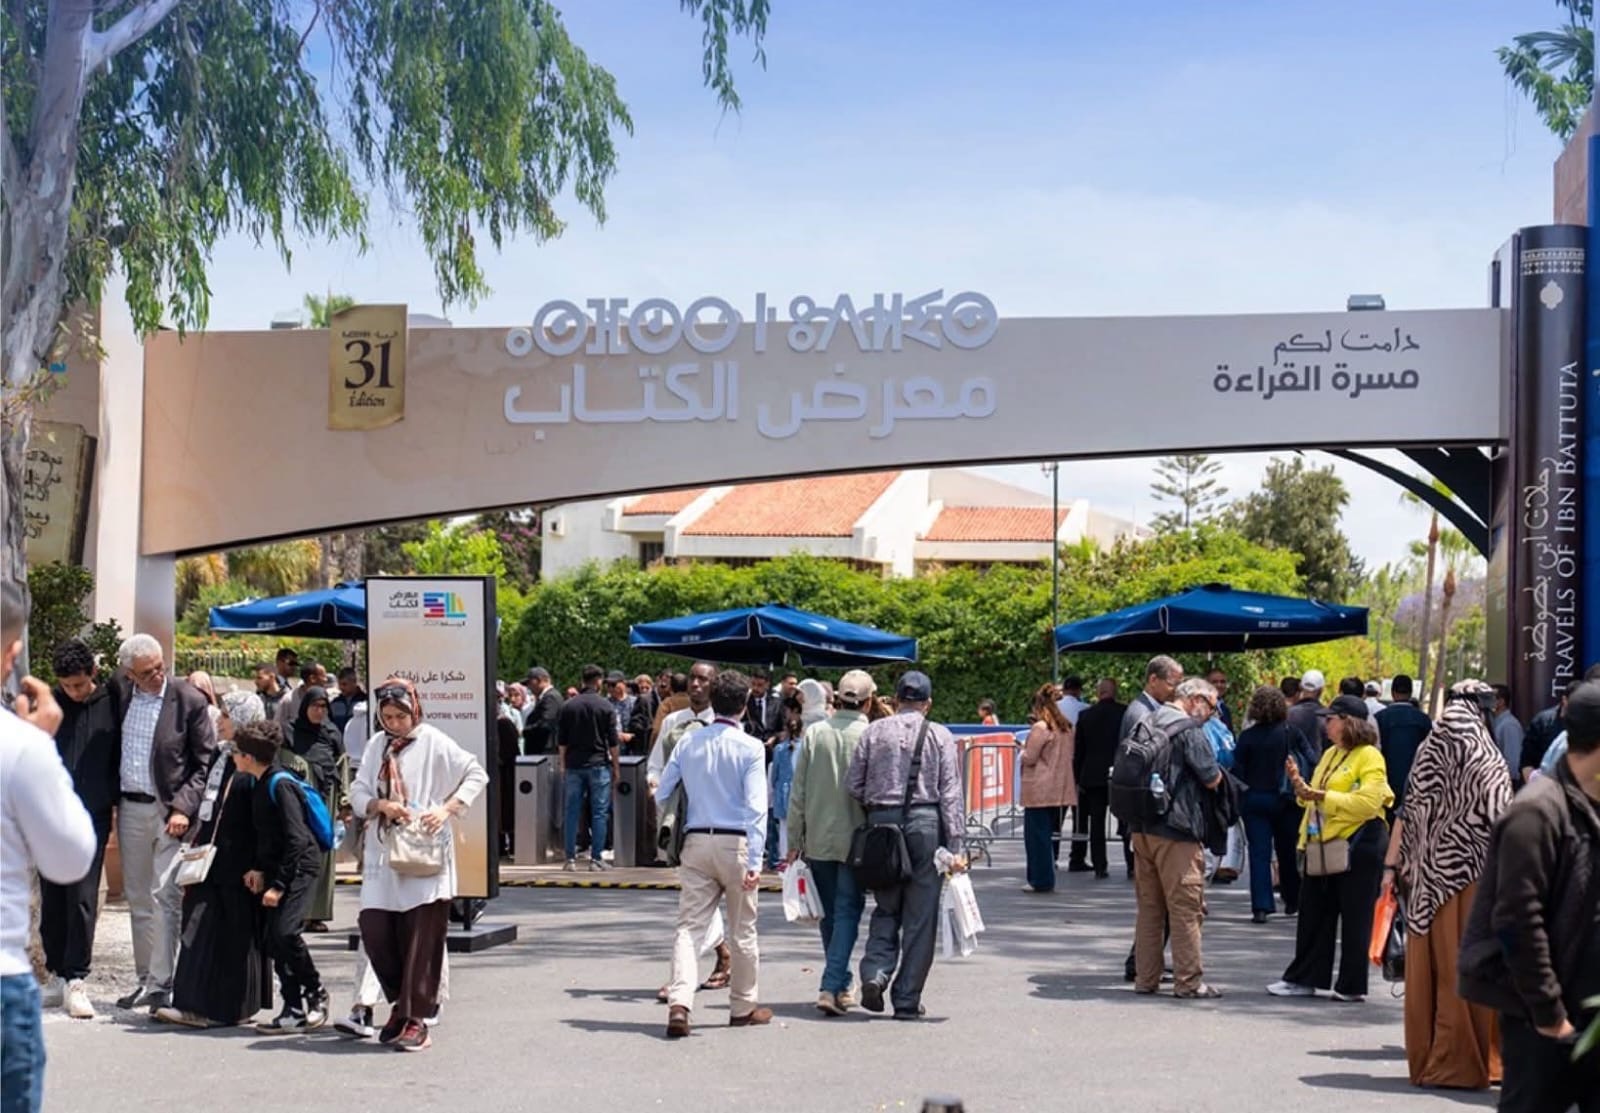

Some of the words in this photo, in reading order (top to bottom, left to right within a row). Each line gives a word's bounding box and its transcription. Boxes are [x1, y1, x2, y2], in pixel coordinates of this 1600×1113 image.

[1273, 329, 1332, 366] لكم
[1340, 327, 1420, 352] دامت
[344, 339, 395, 389] 31
[1213, 362, 1321, 400] القراءة
[1331, 362, 1420, 399] مسرة
[503, 360, 739, 441] الكتاب
[756, 361, 998, 440] معرض
[1555, 360, 1579, 475] BATTUTA
[1555, 487, 1576, 532] IBN
[1522, 535, 1559, 569] ابن
[1556, 543, 1576, 578] OF
[1522, 575, 1559, 662] بطوطة
[1552, 588, 1576, 698] TRAVELS
[421, 669, 439, 684] على
[441, 669, 466, 684] شكرا
[426, 712, 452, 720] VOTRE
[453, 712, 478, 720] VISITE
